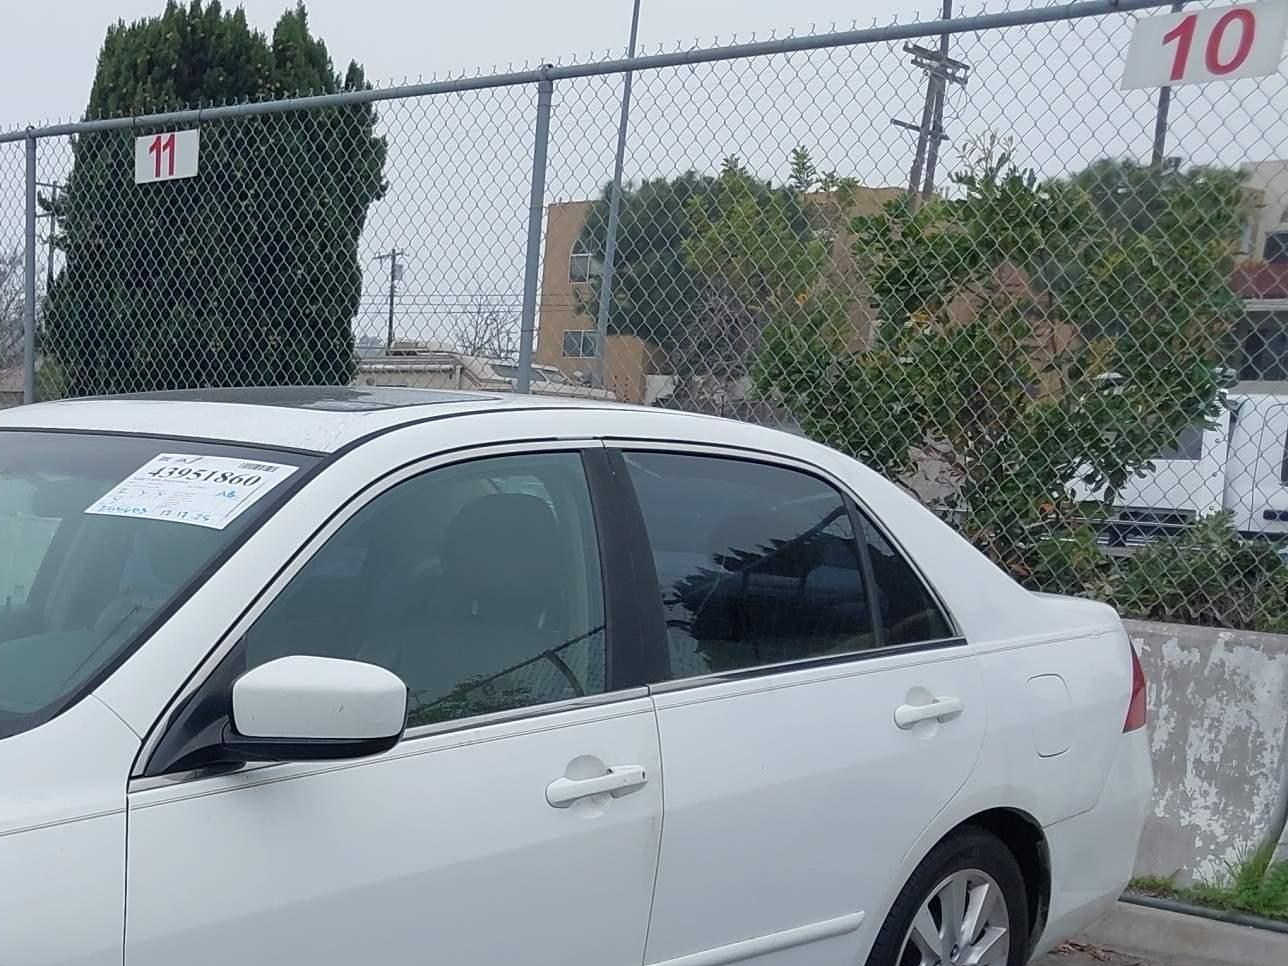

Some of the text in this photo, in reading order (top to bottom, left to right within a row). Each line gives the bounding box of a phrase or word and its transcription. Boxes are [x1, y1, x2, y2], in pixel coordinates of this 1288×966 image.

[1162, 8, 1256, 81] 10
[149, 133, 176, 178] 11
[147, 466, 262, 487] 43951860
